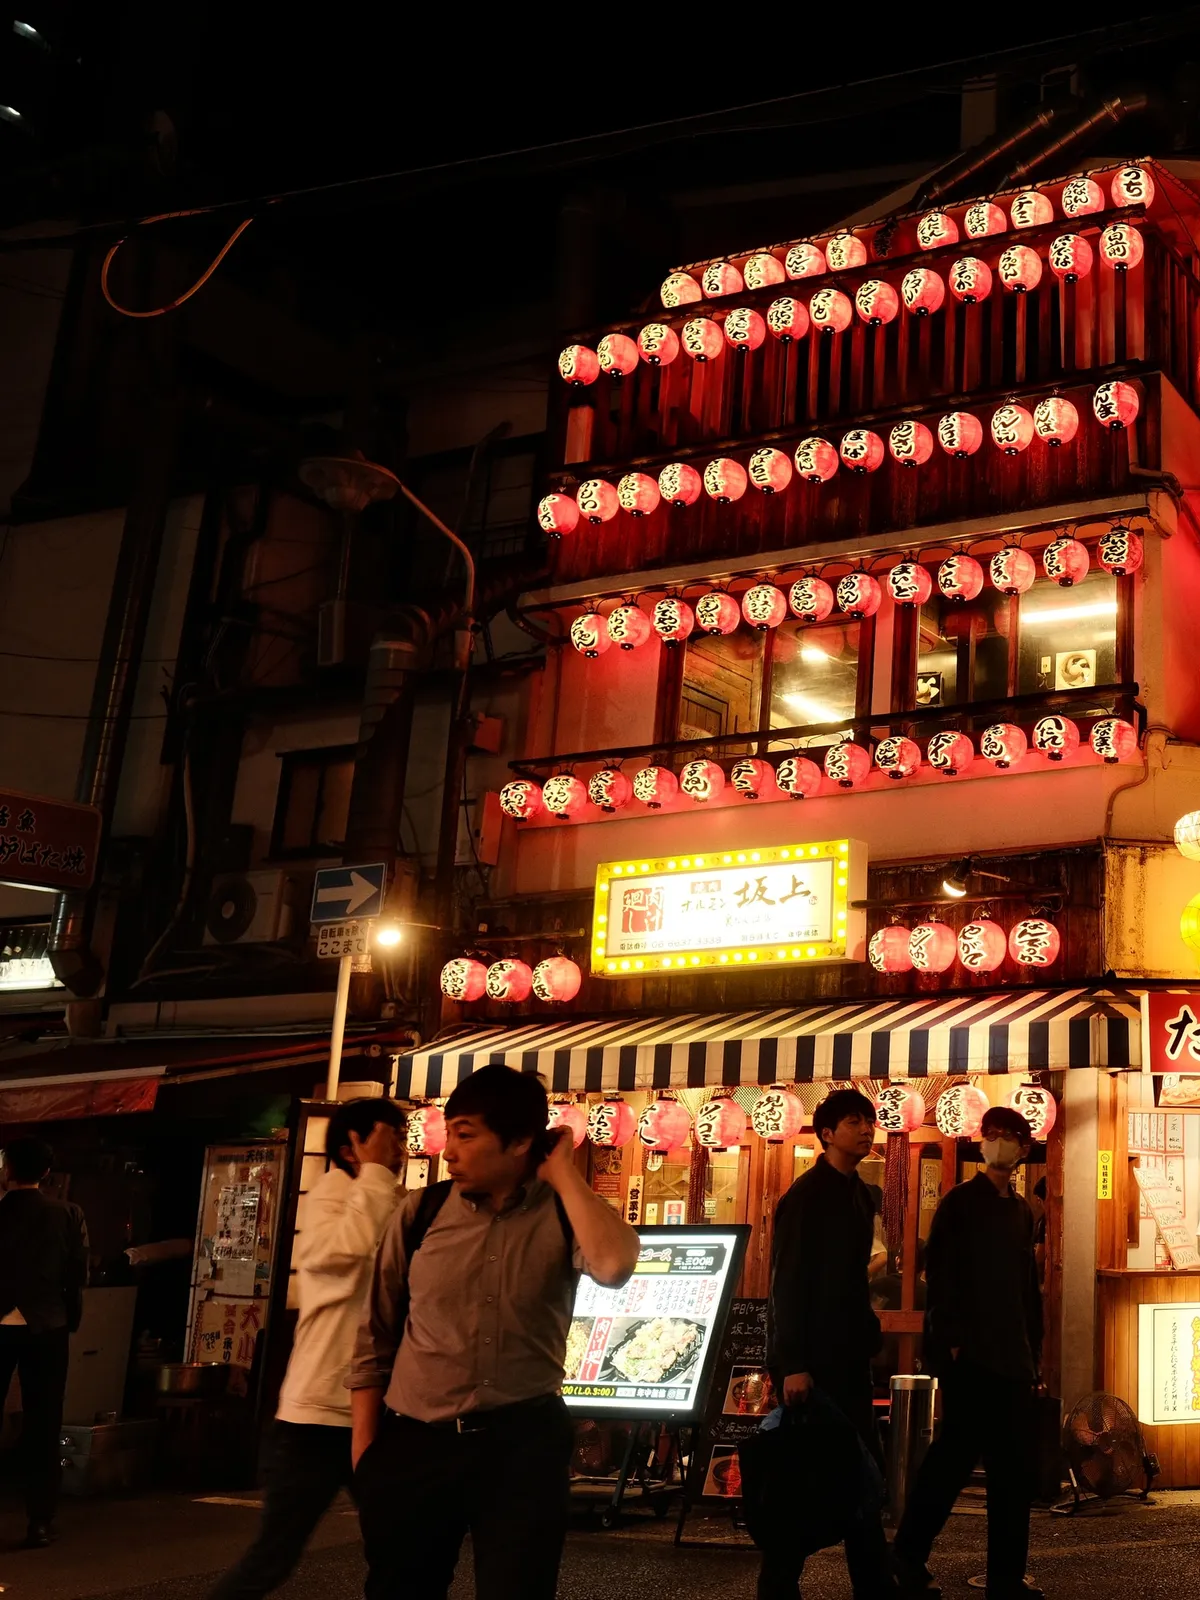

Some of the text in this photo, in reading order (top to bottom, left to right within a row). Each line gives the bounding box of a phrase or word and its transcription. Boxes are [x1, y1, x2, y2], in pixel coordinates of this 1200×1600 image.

[891, 564, 918, 598] まいど
[1036, 717, 1064, 750] へたれ
[734, 874, 811, 908] 坂上
[319, 939, 364, 956] ここまで
[699, 1104, 722, 1145] ツッコミ
[628, 1188, 641, 1223] 営業中
